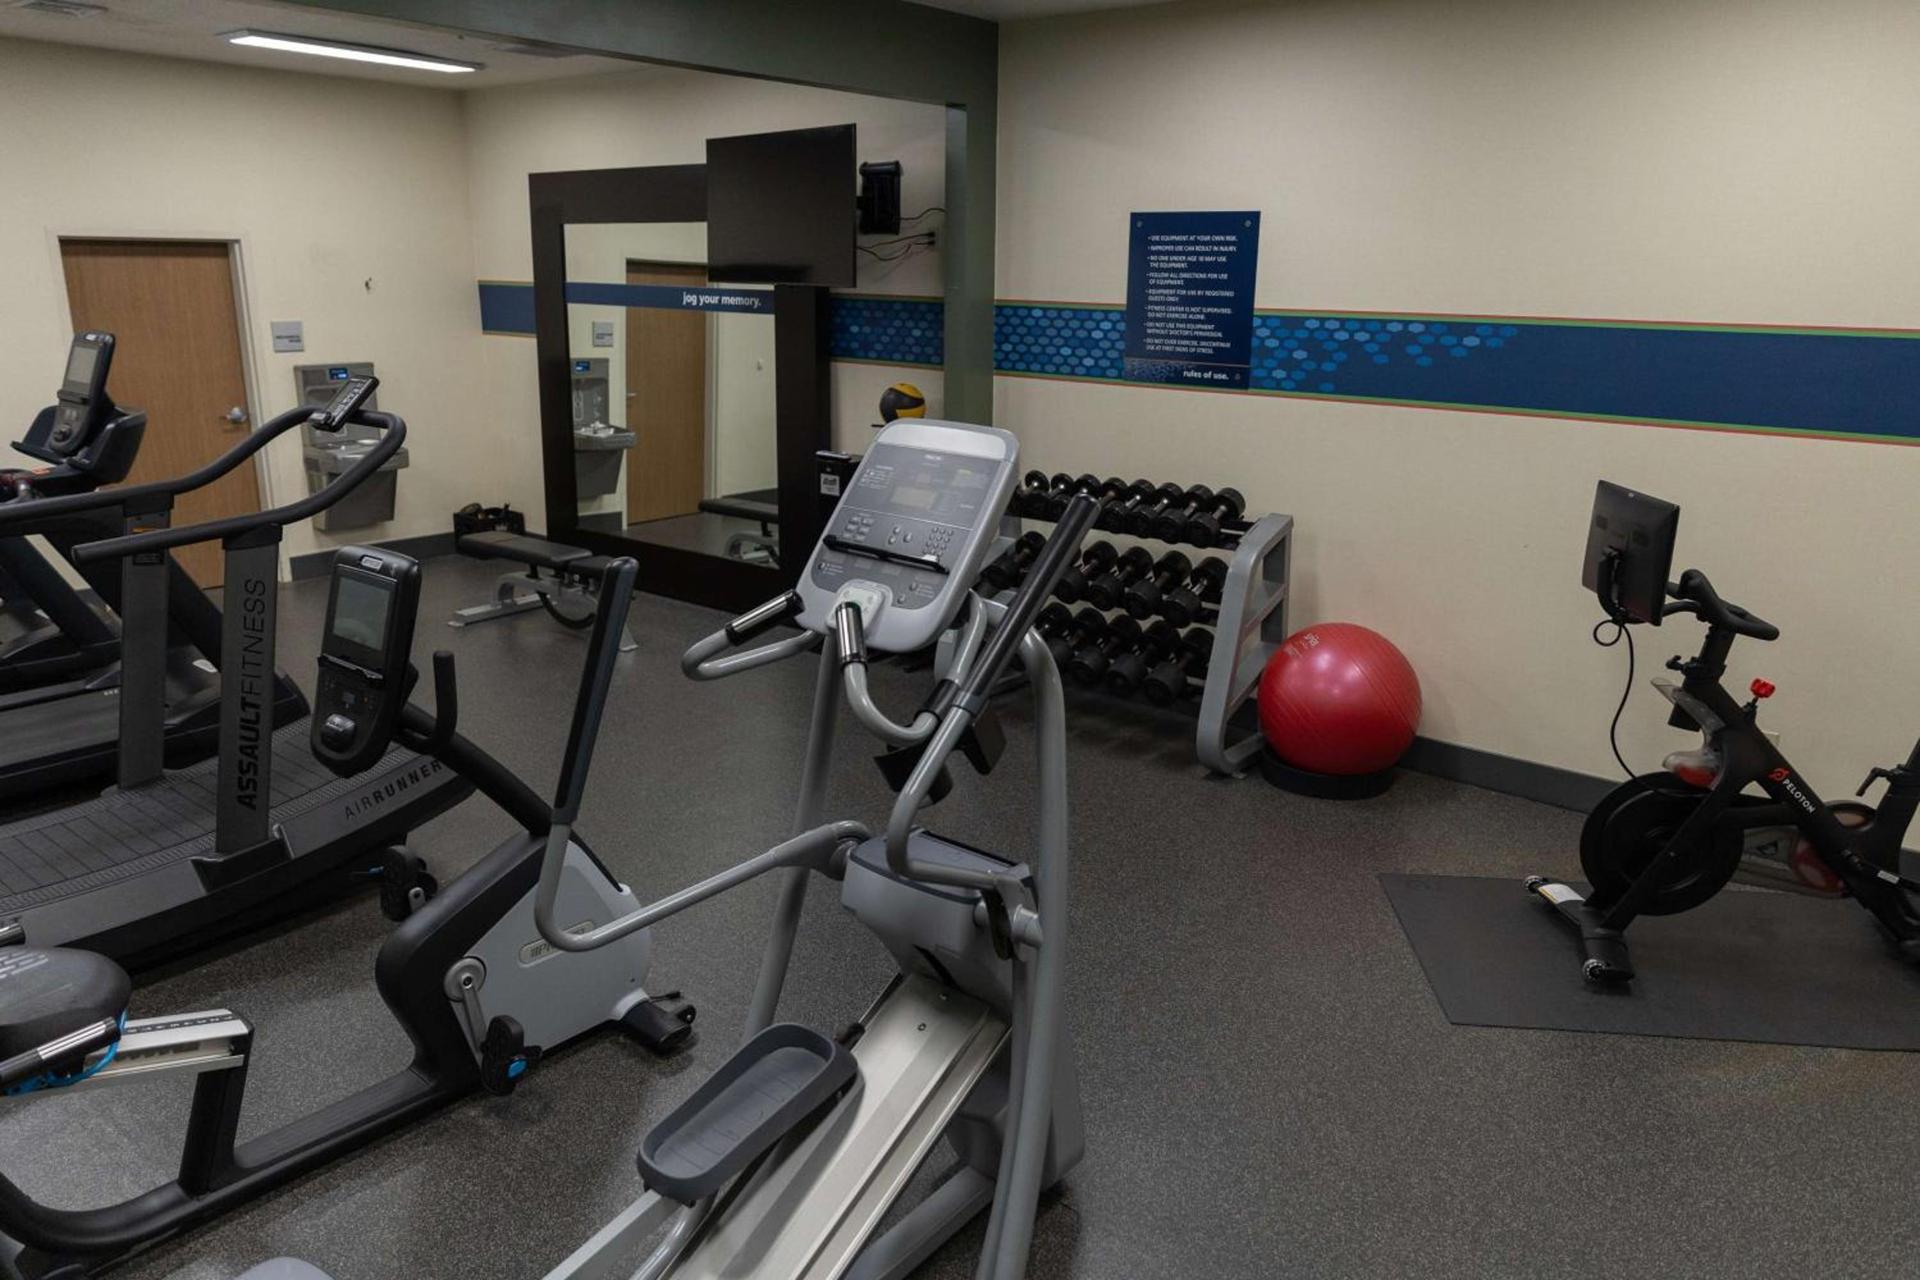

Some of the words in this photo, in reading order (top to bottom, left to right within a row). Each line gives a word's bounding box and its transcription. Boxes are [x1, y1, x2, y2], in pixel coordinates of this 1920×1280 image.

[682, 291, 697, 306] jog
[698, 295, 720, 306] your
[720, 296, 761, 309] memory.
[1183, 369, 1202, 379] rules
[1203, 371, 1212, 379] of
[1213, 373, 1229, 381] use.
[1783, 778, 1816, 813] PELOTON
